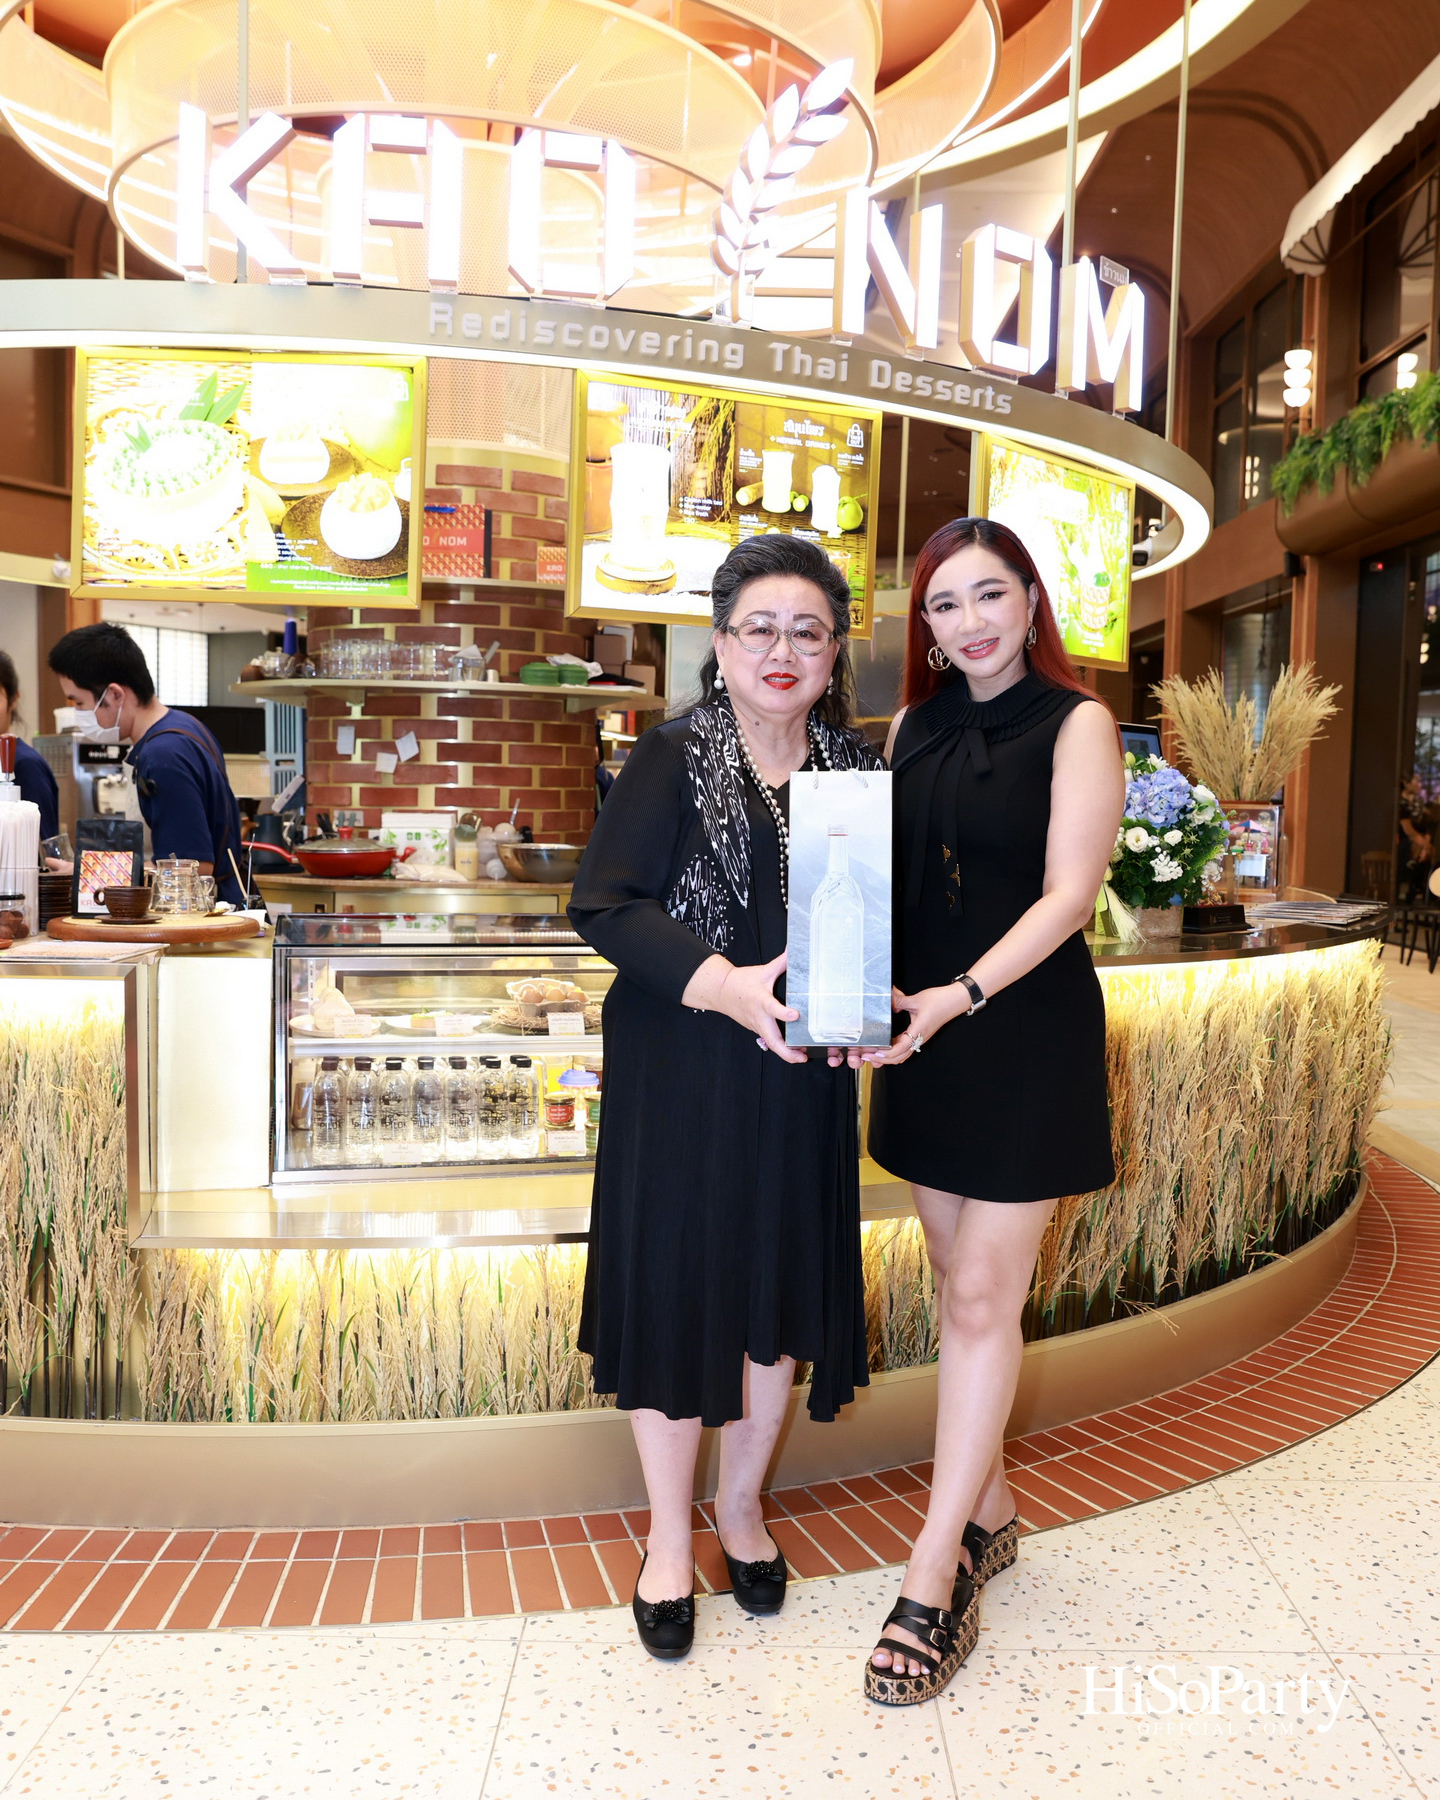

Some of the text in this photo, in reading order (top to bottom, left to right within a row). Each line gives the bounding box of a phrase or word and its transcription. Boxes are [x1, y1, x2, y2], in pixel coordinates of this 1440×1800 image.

[176, 101, 1146, 413] KAO NOM
[428, 300, 1013, 416] Rediscovering Thai Desserts
[439, 535, 467, 547] NOM
[546, 564, 563, 572] KAO
